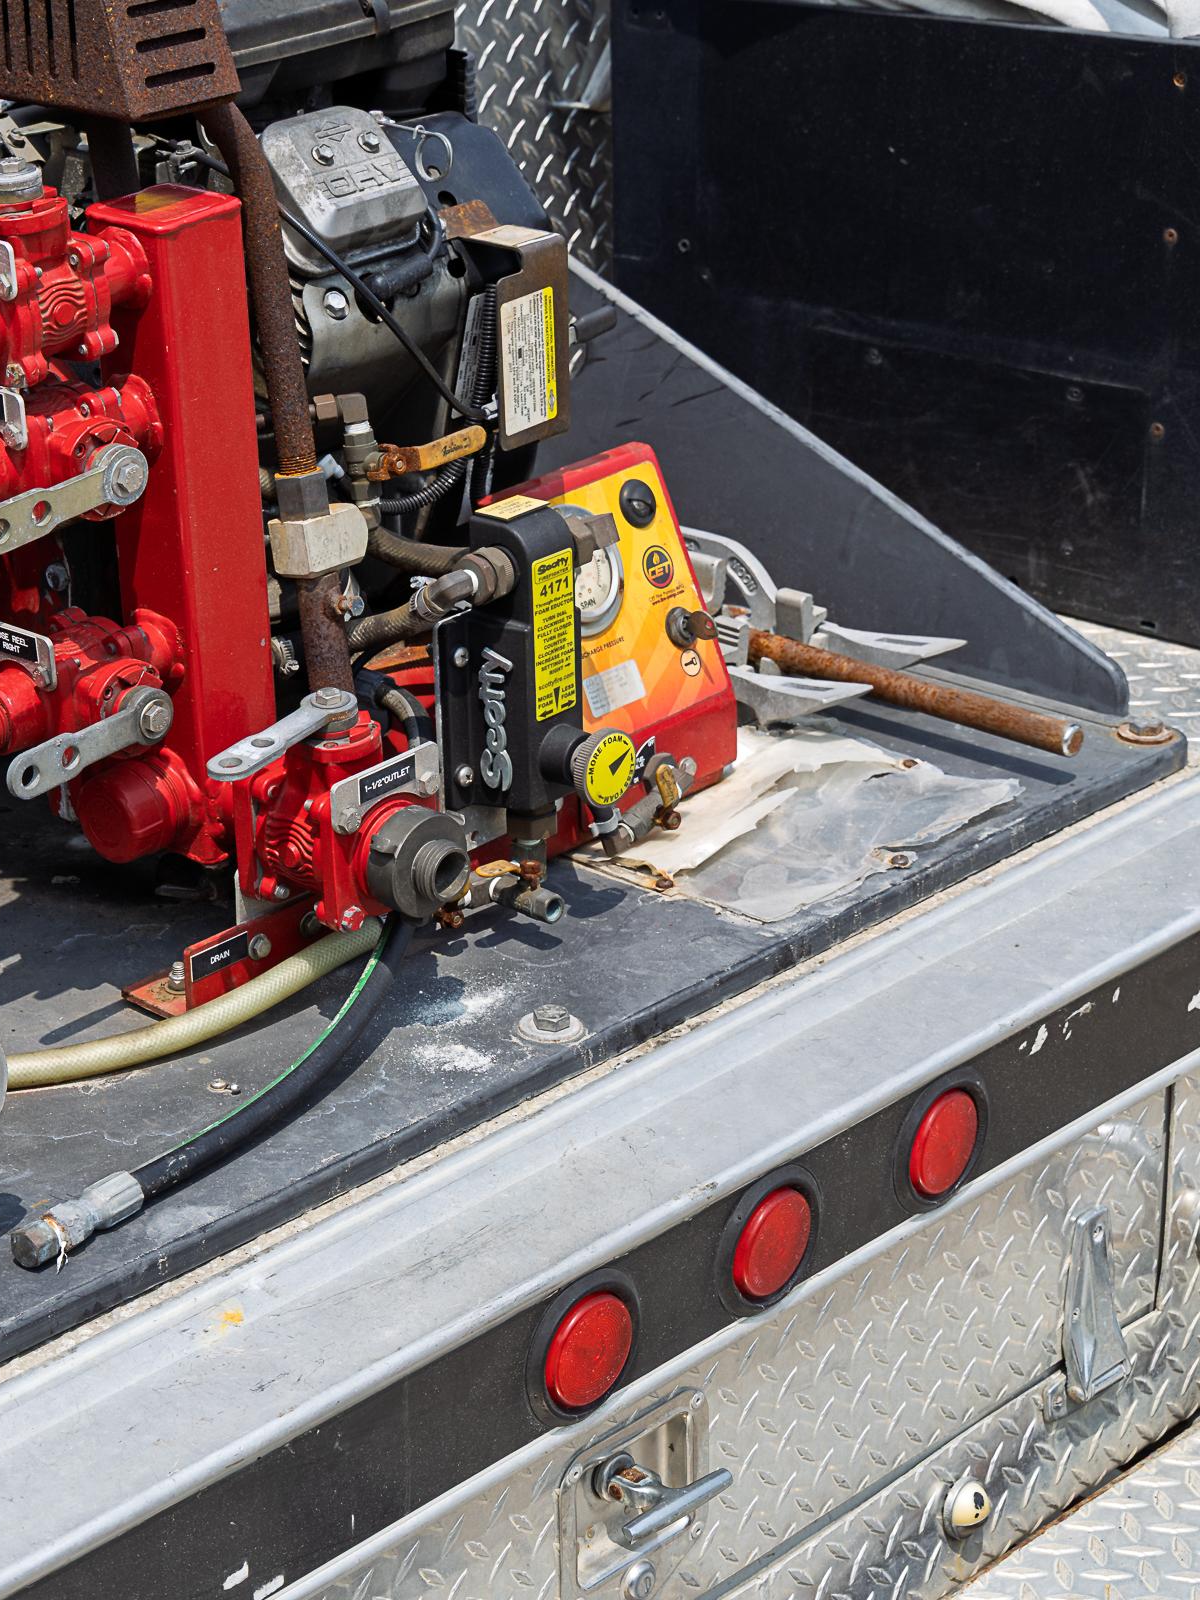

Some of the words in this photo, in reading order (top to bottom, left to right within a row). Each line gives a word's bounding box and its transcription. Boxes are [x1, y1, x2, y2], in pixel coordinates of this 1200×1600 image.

[537, 556, 569, 576] Scotty
[648, 561, 670, 580] CET
[538, 566, 569, 582] FIREFIGHTER
[540, 576, 569, 597] 4171
[580, 597, 597, 610] SPAN
[535, 606, 550, 616] FOAM
[537, 617, 565, 632] CLOCKWISE
[537, 629, 553, 639] FULLY
[2, 641, 20, 654] RIGHT
[11, 635, 29, 648] REEL
[603, 636, 625, 649] PRESSURE
[537, 644, 565, 659] CLOCKWISE
[536, 654, 560, 667] INCREASE
[561, 683, 574, 692] LESS
[561, 690, 575, 699] FOAM
[537, 692, 553, 702] MORE
[537, 699, 553, 709] FOAM
[478, 646, 514, 792] Scotty
[588, 747, 603, 775] MORE
[602, 735, 623, 748] FOAM
[623, 763, 635, 788] LESS
[603, 788, 624, 803] FOAM
[210, 949, 231, 965] DRAIN
